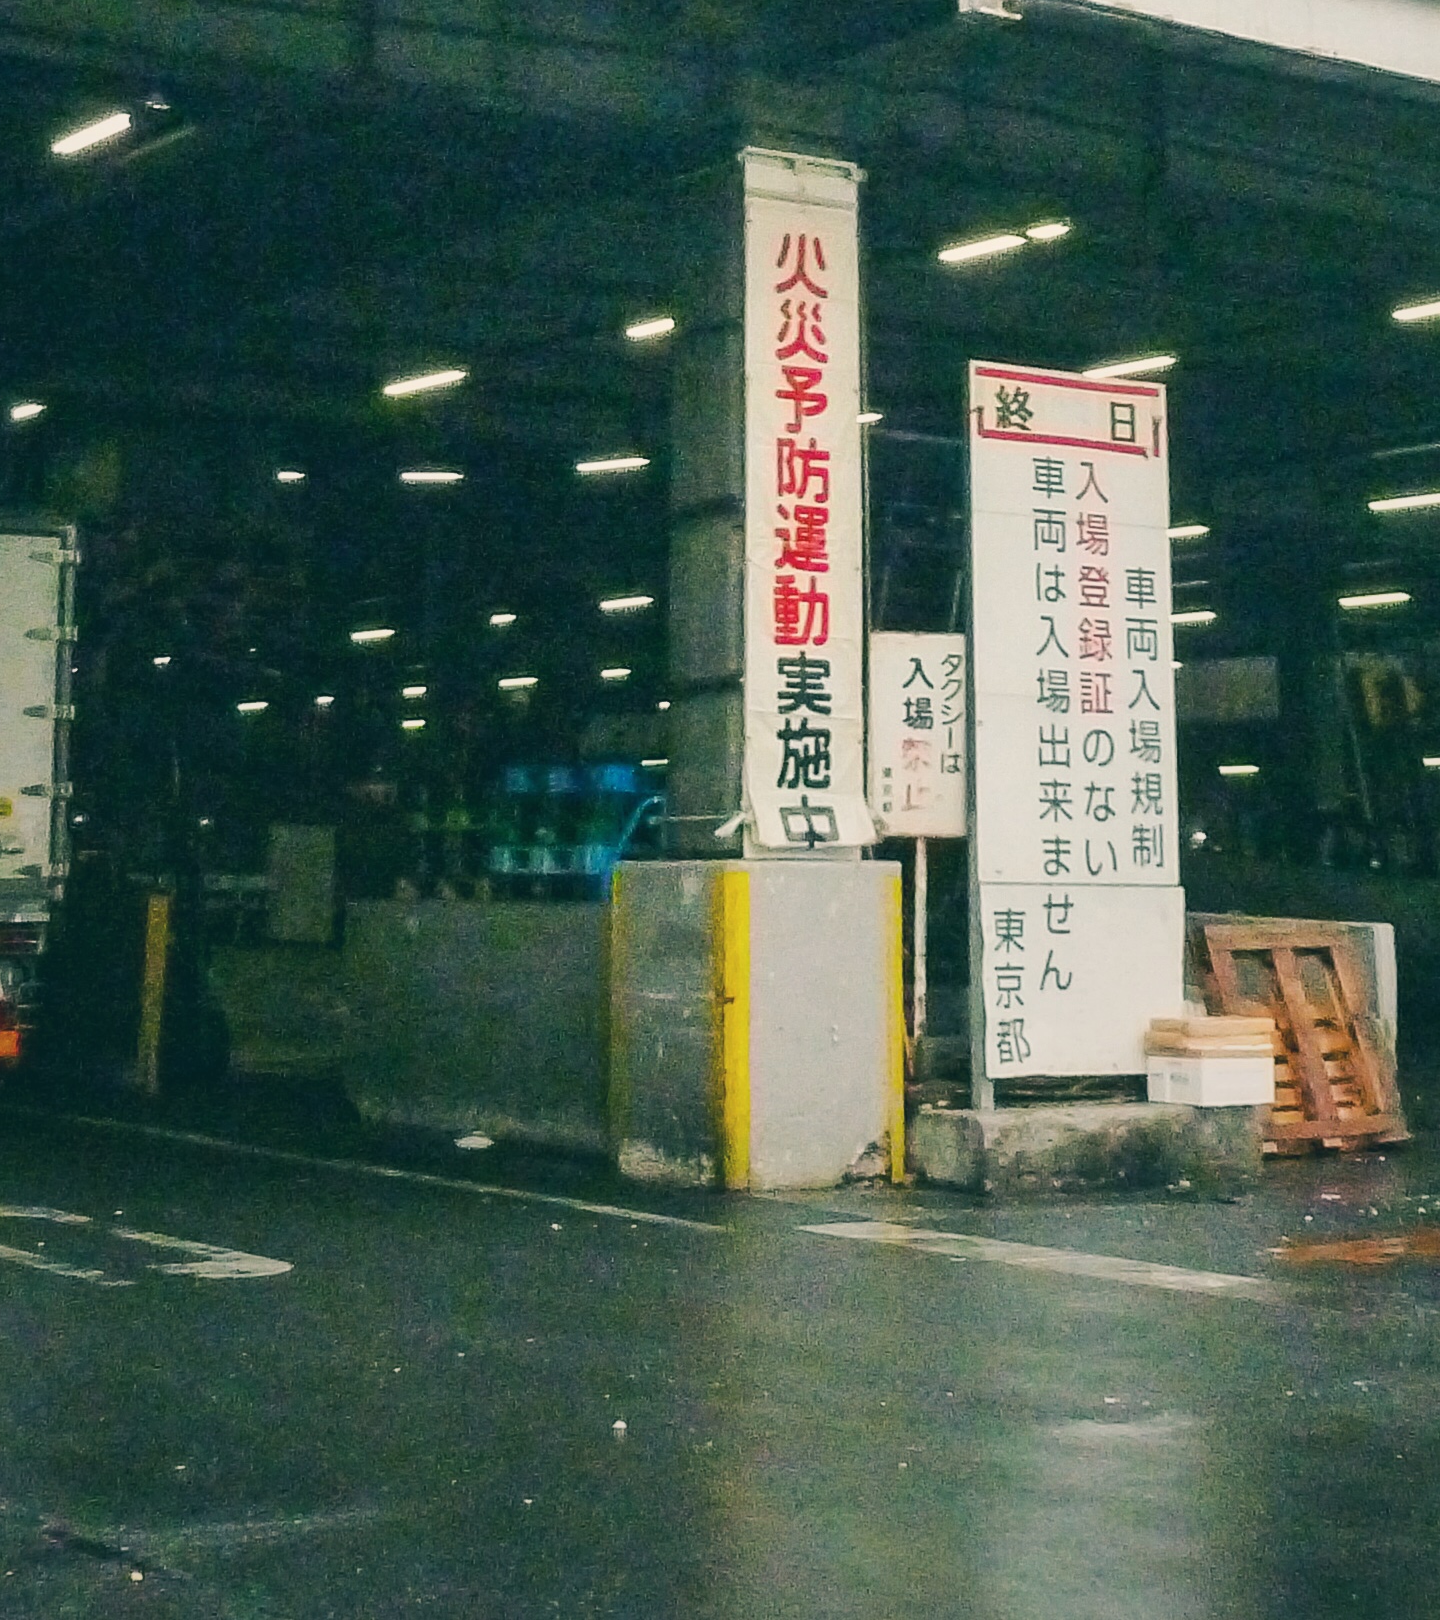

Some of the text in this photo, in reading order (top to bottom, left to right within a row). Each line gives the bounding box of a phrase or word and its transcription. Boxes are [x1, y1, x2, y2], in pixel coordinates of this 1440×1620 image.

[774, 232, 837, 850] 火災予防運動実施中
[940, 653, 964, 774] タクシーは
[1075, 460, 1119, 877] 入場登録証のない
[1123, 566, 1165, 869] 車両入場規制
[1033, 456, 1075, 992] 車両は入場出来ません
[993, 909, 1032, 1065] 東京都
